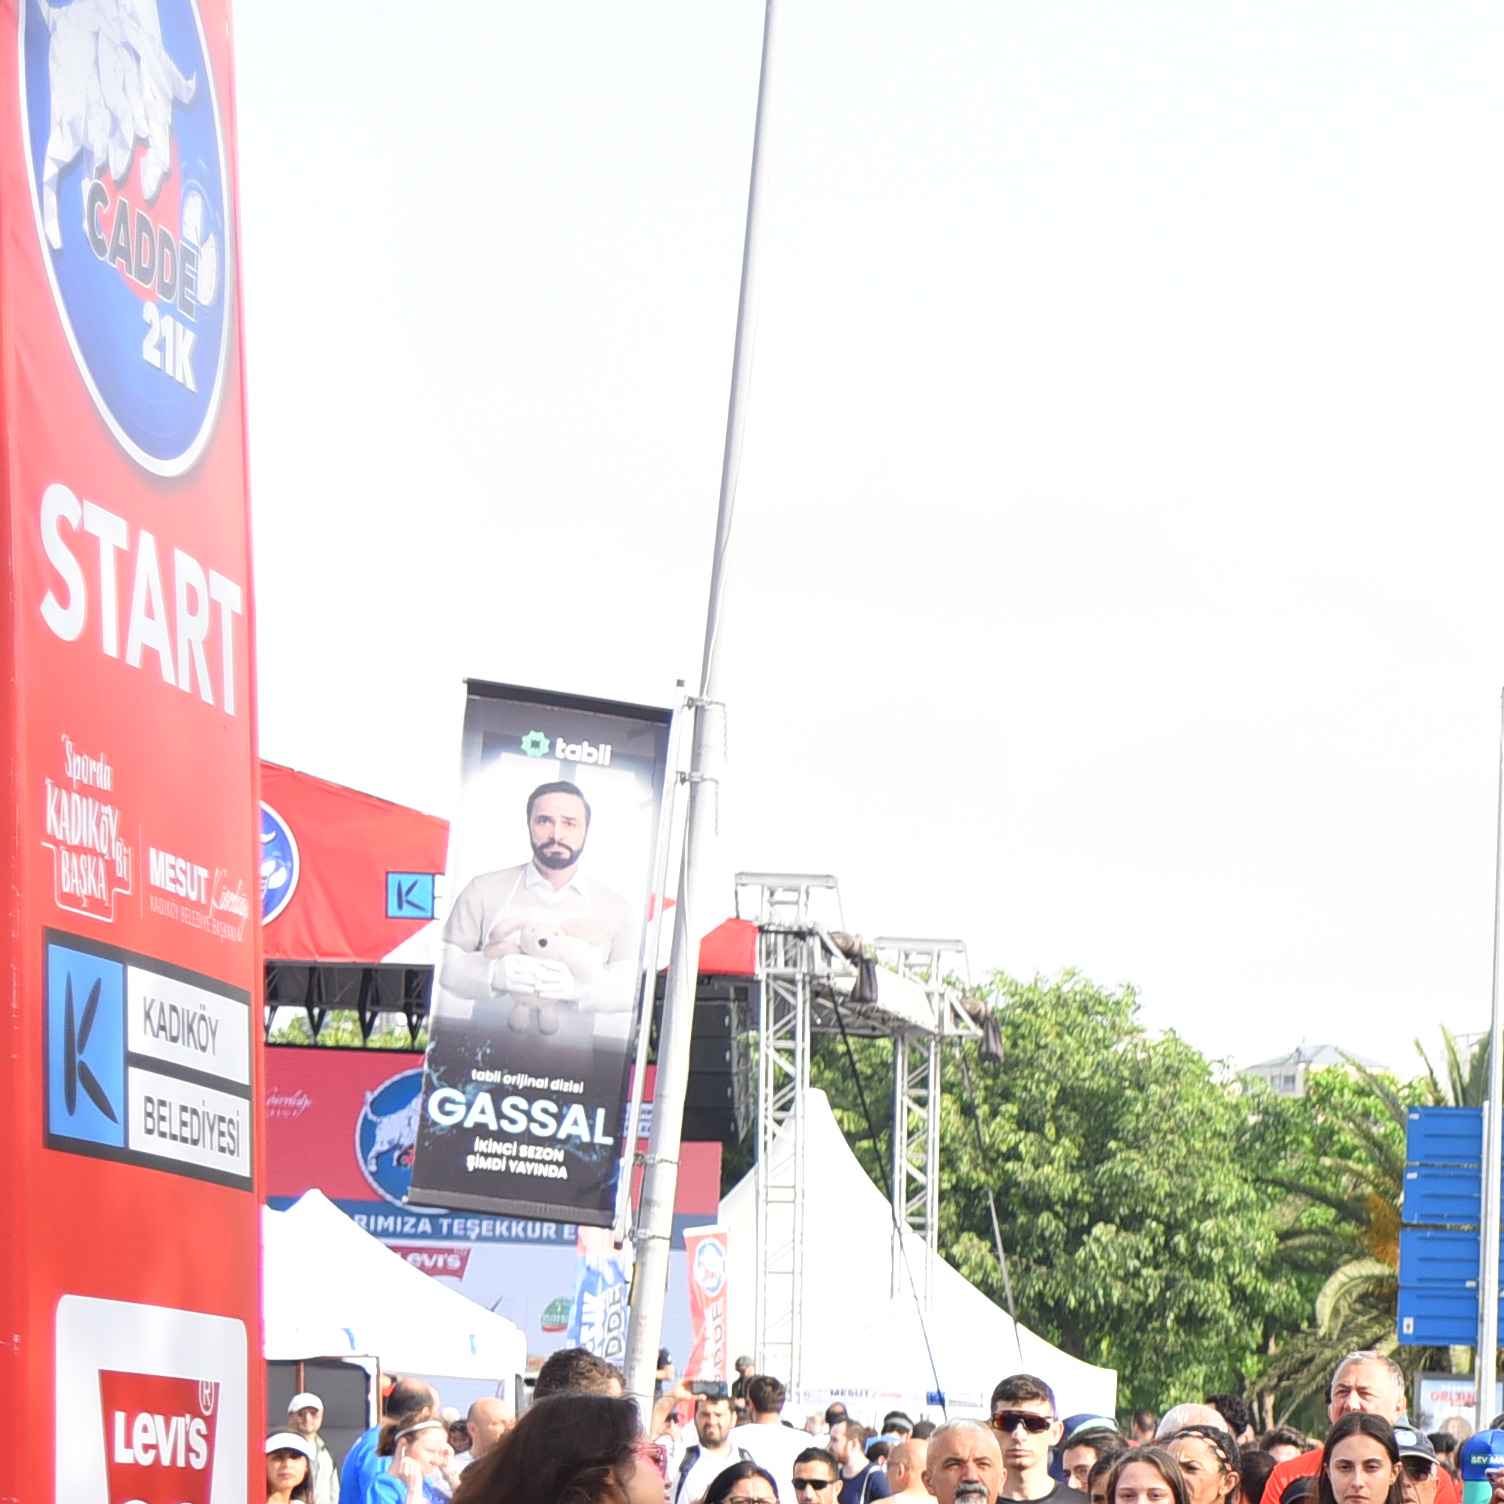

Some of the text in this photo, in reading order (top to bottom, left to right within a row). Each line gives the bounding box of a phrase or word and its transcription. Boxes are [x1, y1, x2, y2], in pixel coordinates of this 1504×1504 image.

[86, 178, 200, 317] CADDE
[142, 302, 198, 393] 21K
[39, 483, 242, 717] START
[61, 733, 114, 793] Sporda
[45, 778, 119, 861] KADIKÖY
[60, 845, 108, 908] BAŞKA
[149, 847, 208, 905] MESUT
[143, 994, 220, 1057] KADIKÖY
[143, 1093, 242, 1158] BELEDİYESİ
[428, 1086, 615, 1146] GASSAL
[474, 1136, 564, 1163] İKİNCİ SEZON
[508, 1158, 568, 1181] YAYINDA
